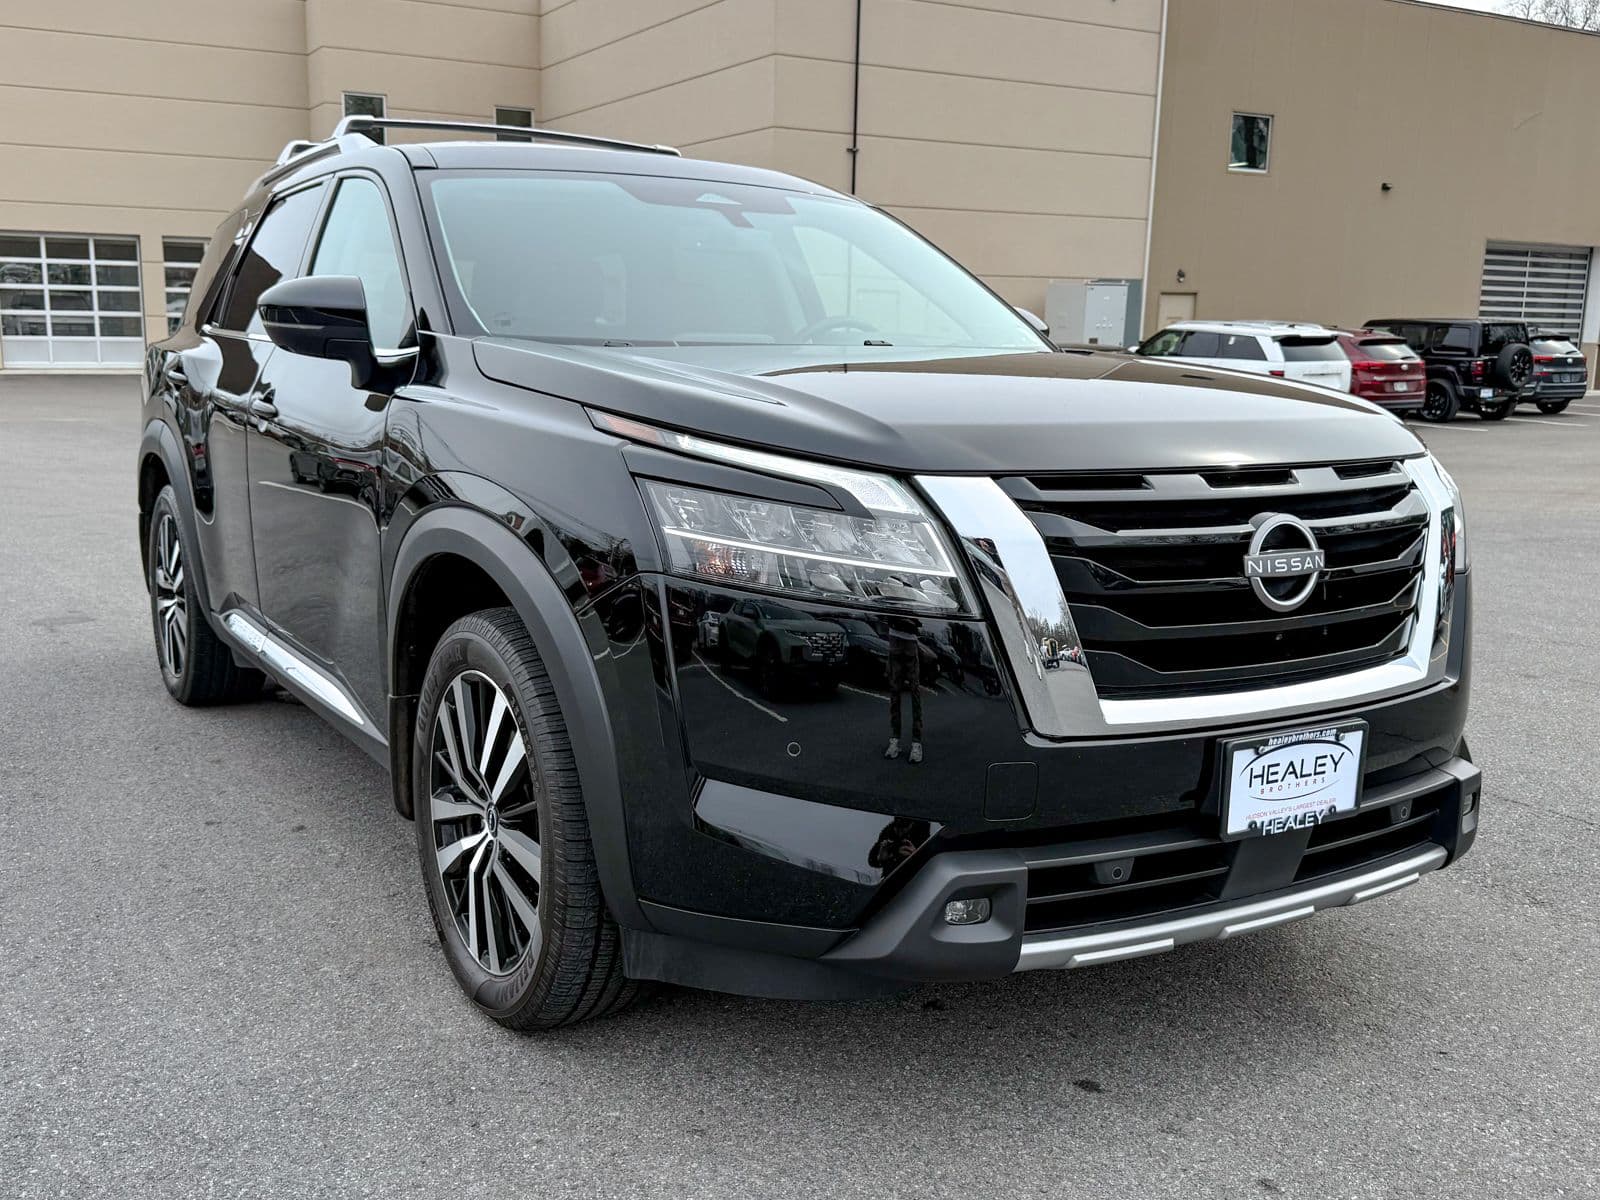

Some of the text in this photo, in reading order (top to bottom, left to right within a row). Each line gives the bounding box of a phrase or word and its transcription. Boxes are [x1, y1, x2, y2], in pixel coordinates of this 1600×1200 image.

[1247, 555, 1324, 574] NISSAN
[1268, 729, 1337, 745] healeybrothers.com
[1249, 752, 1345, 788] HEALEY
[1260, 777, 1326, 795] BROTHERS
[1245, 798, 1336, 821] HUDSON VALLEY'S LARGEST DEALER
[1262, 810, 1325, 836] HEALEY
